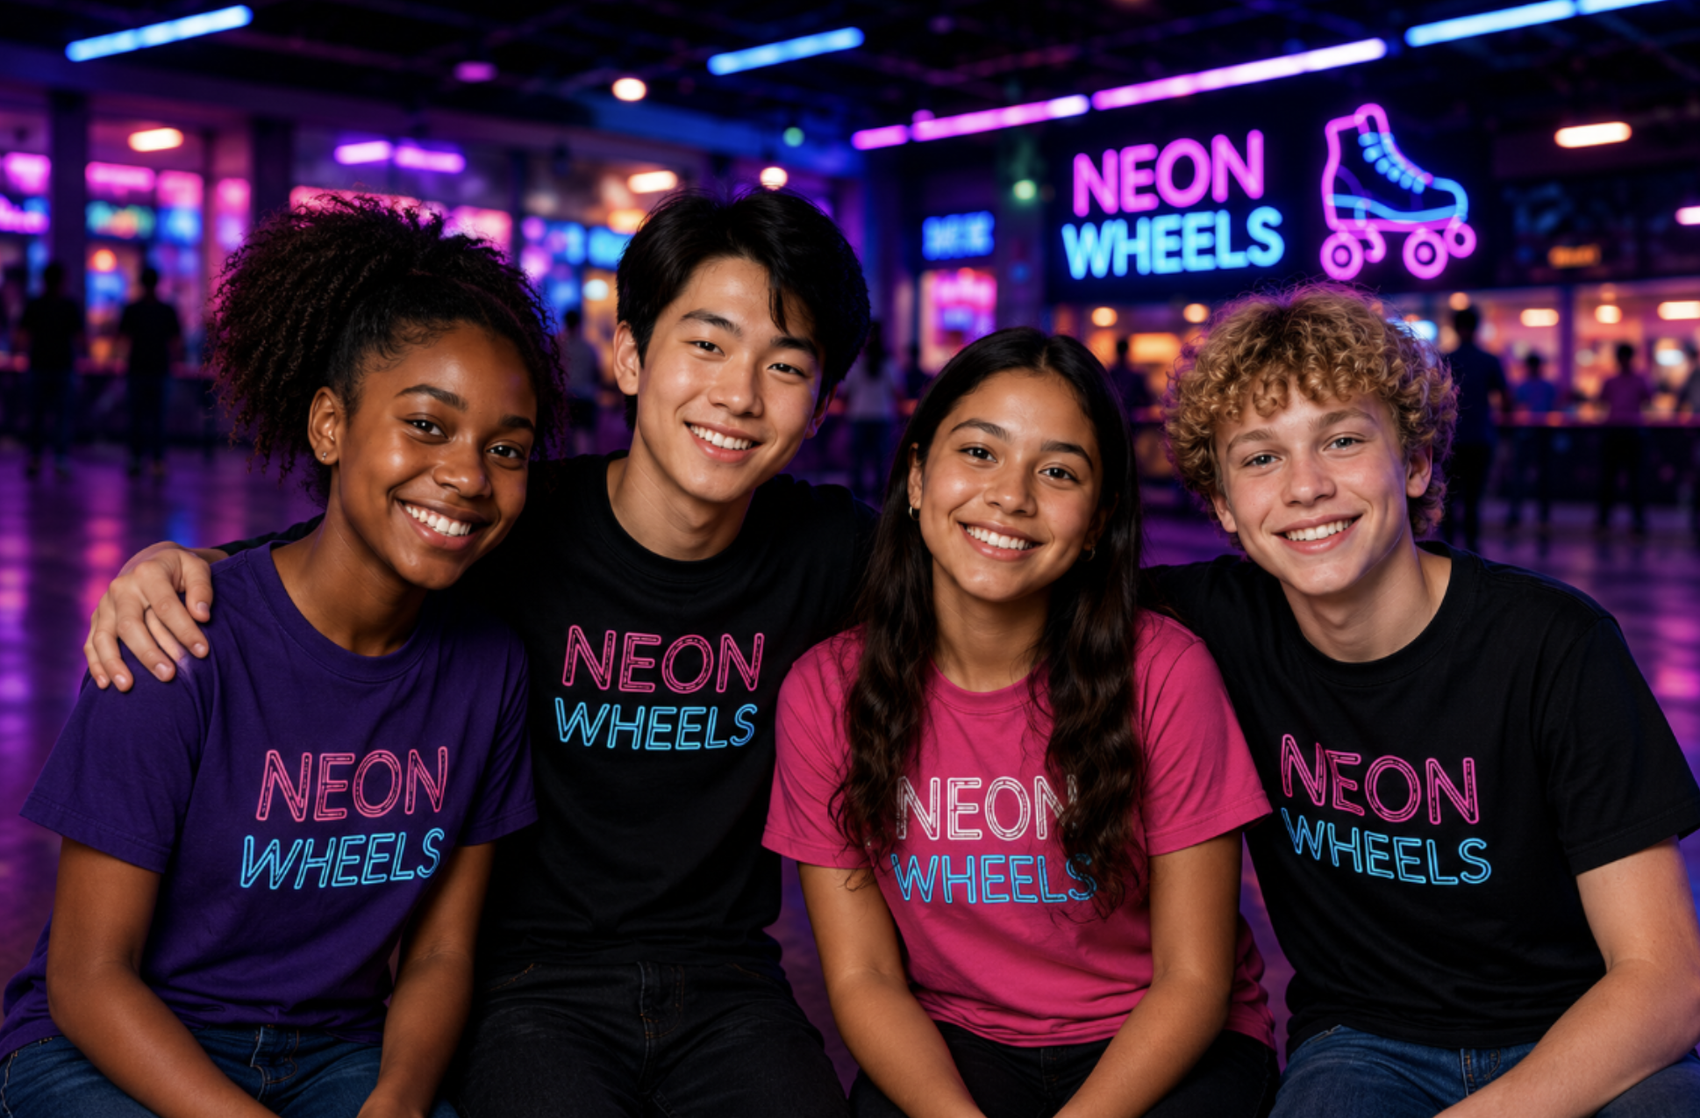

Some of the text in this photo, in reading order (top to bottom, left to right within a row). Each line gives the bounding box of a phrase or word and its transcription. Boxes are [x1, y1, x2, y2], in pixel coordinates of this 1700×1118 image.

[1073, 129, 1264, 218] NEON
[1061, 206, 1285, 280] WHEELS
[562, 625, 764, 693] NEON
[555, 698, 758, 750] WHEELS
[256, 746, 448, 822] NEON
[1281, 734, 1479, 825] NEON
[240, 828, 445, 889] WHEELS
[890, 853, 1098, 904] WHEELS
[1281, 807, 1492, 885] WHEELS
